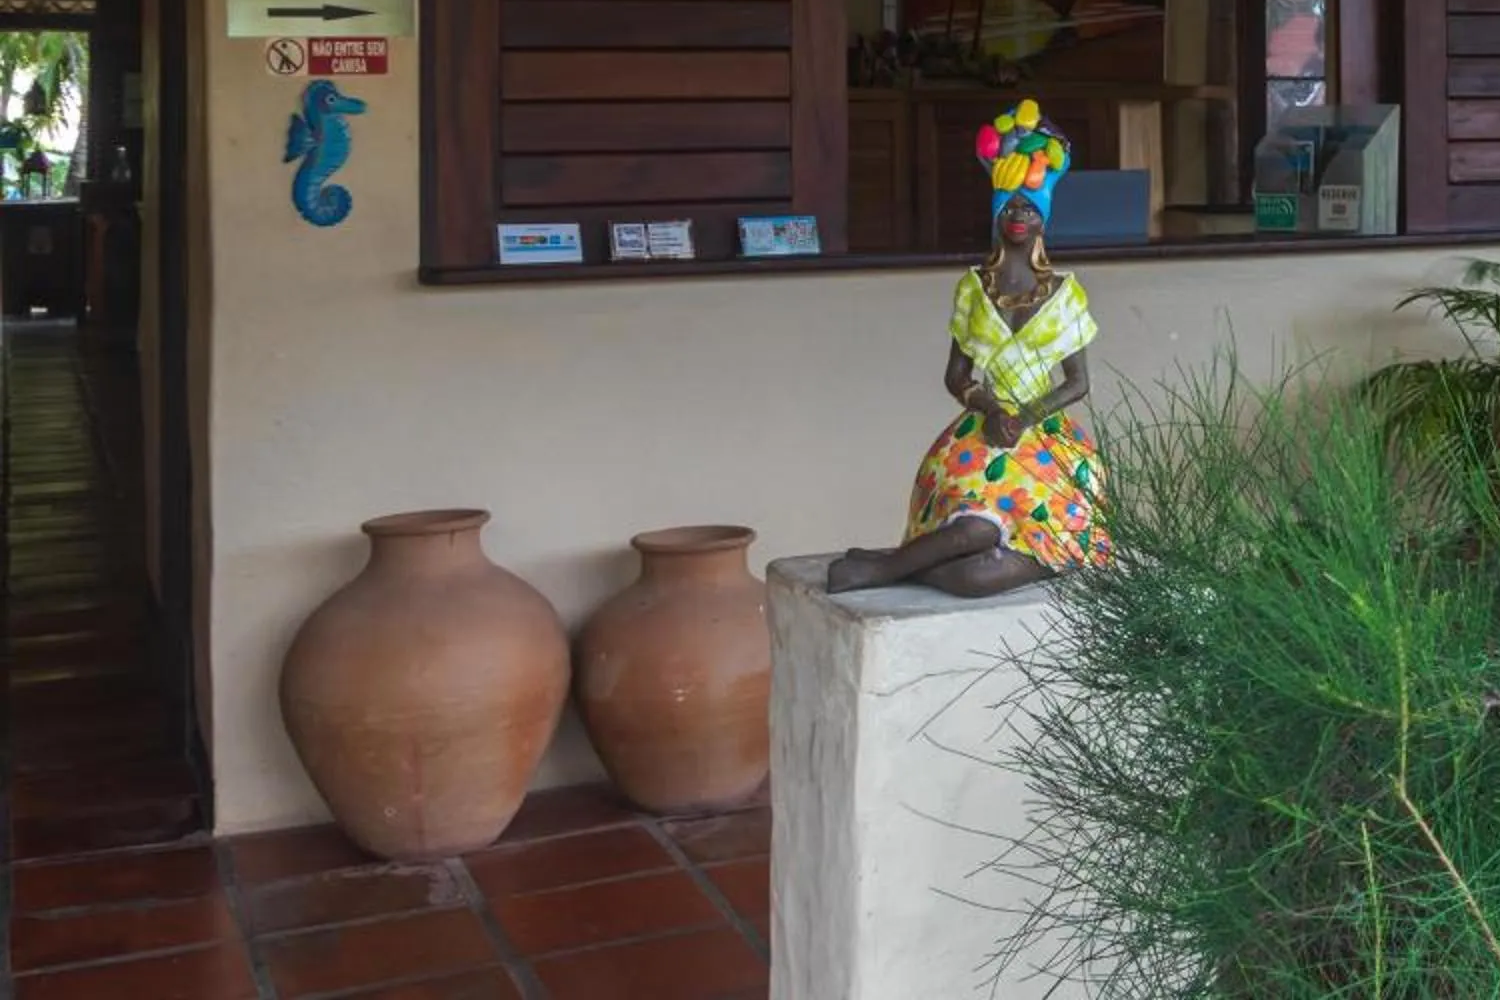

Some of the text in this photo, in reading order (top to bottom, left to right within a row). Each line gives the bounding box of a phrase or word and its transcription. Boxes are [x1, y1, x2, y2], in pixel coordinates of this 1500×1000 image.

[311, 41, 386, 57] NÃO ENTRE SEM
[331, 58, 367, 73] CAMISA
